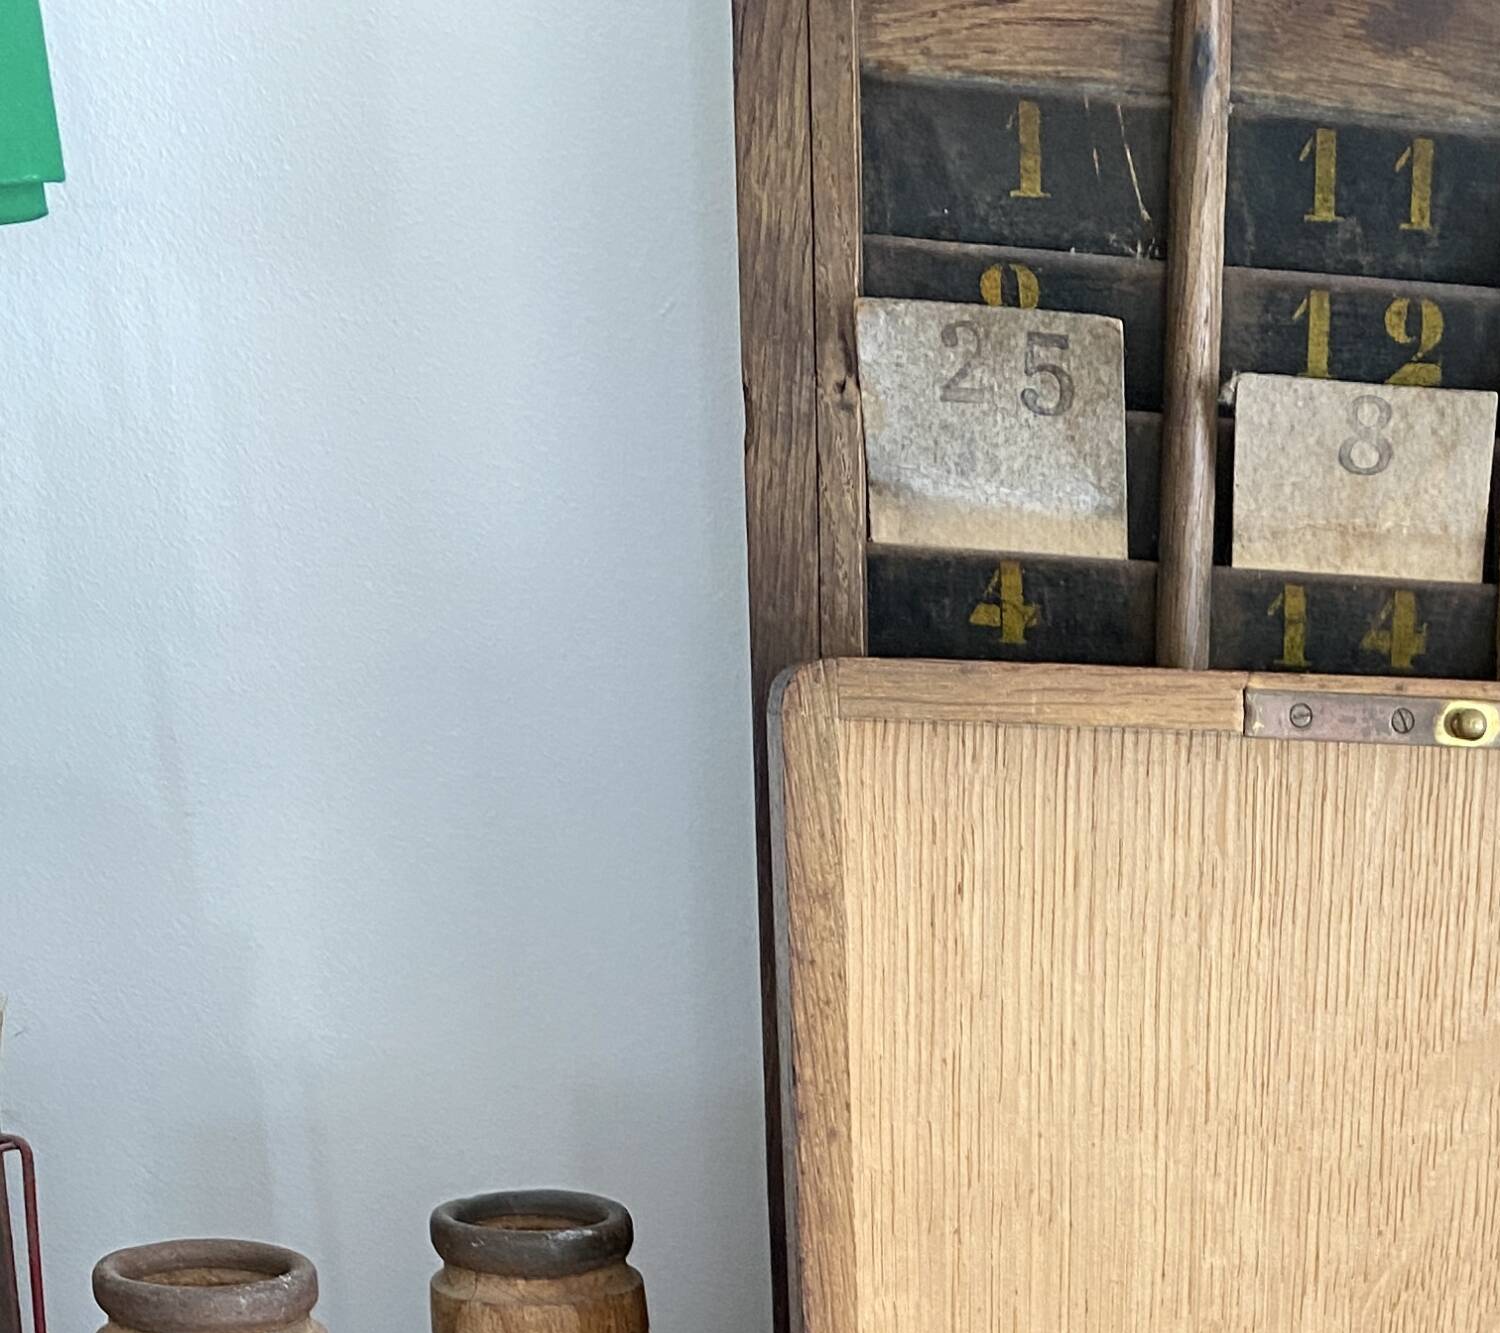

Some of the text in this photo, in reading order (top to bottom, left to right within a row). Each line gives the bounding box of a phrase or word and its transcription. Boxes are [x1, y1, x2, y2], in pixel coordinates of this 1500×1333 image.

[1006, 101, 1051, 198] 1
[1299, 129, 1434, 231] 11
[939, 320, 1076, 417] 25
[1292, 290, 1444, 388] 12
[1338, 396, 1393, 476] 8
[970, 561, 1040, 644] 4
[1268, 585, 1427, 669] 14
